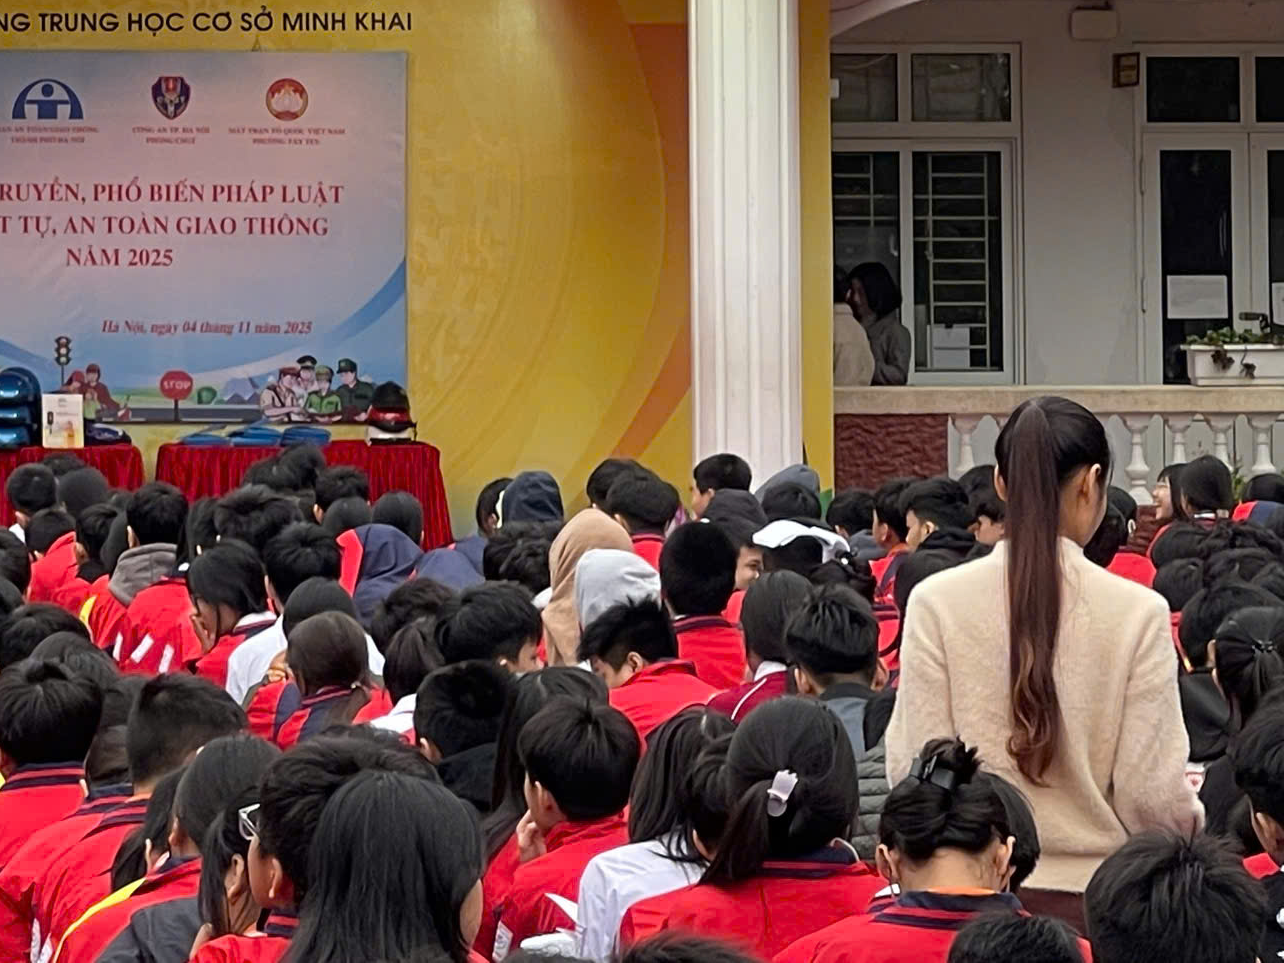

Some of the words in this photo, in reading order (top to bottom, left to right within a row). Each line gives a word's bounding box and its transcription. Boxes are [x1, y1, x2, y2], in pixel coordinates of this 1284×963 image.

[37, 12, 120, 32] TRUNG
[127, 12, 185, 37] HỌC
[192, 11, 233, 32] CƠ
[240, 5, 274, 32] SỞ
[282, 11, 347, 32] MINH
[355, 12, 412, 32] KHAI
[92, 175, 143, 203] PHỔ
[149, 177, 205, 204] BIẾN
[211, 179, 275, 204] PHÁP
[281, 180, 345, 209] LUẬT
[17, 215, 57, 239] TỰ,
[63, 215, 96, 235] AN
[102, 211, 169, 235] TOÀN
[175, 215, 238, 236] GIAO
[243, 212, 329, 237] THÔNG
[65, 244, 121, 267] NĂM
[127, 248, 174, 267] 2025
[182, 320, 198, 334] 04
[237, 320, 252, 334] 11
[283, 320, 314, 335] 2025
